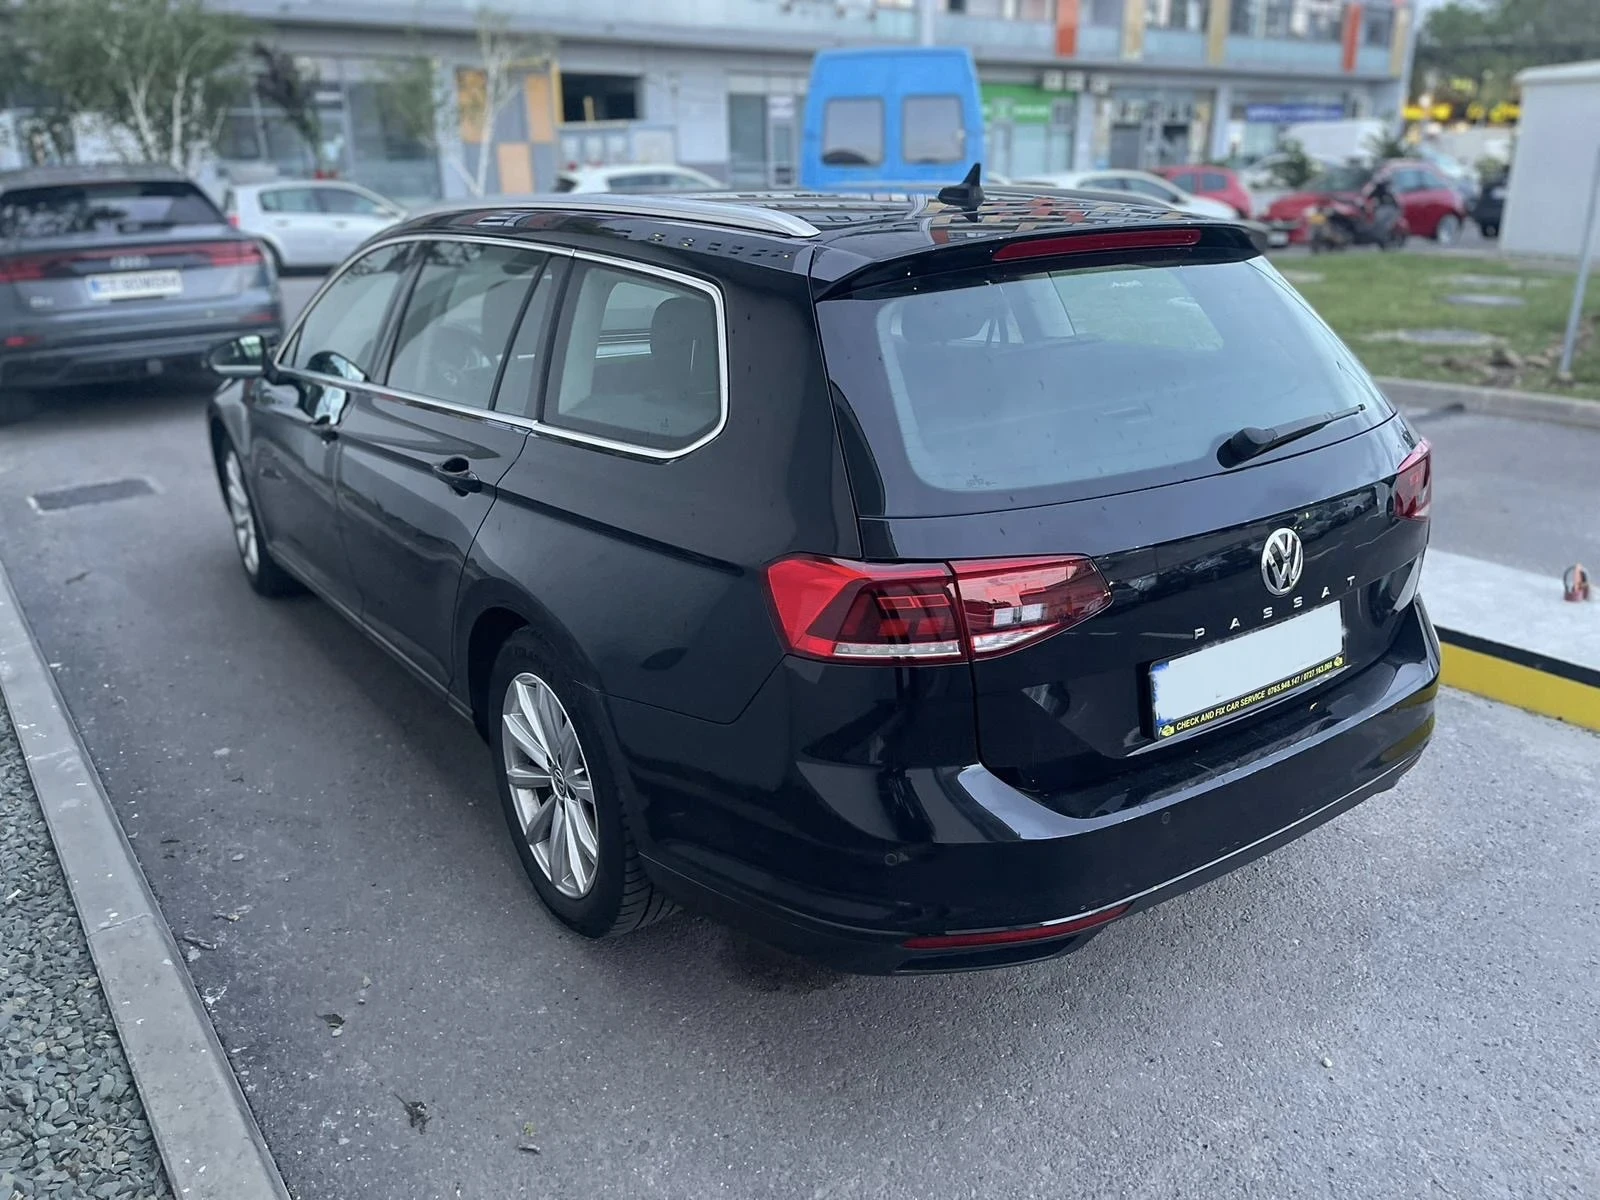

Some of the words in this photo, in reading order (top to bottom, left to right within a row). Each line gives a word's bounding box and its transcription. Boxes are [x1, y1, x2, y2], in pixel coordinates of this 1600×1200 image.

[1194, 576, 1355, 640] PASSAT
[1176, 716, 1200, 730] CHECK
[1200, 710, 1214, 722] AND
[1215, 706, 1226, 717] FIX
[1226, 701, 1240, 712] CAR
[1240, 690, 1266, 707] SERVICE
